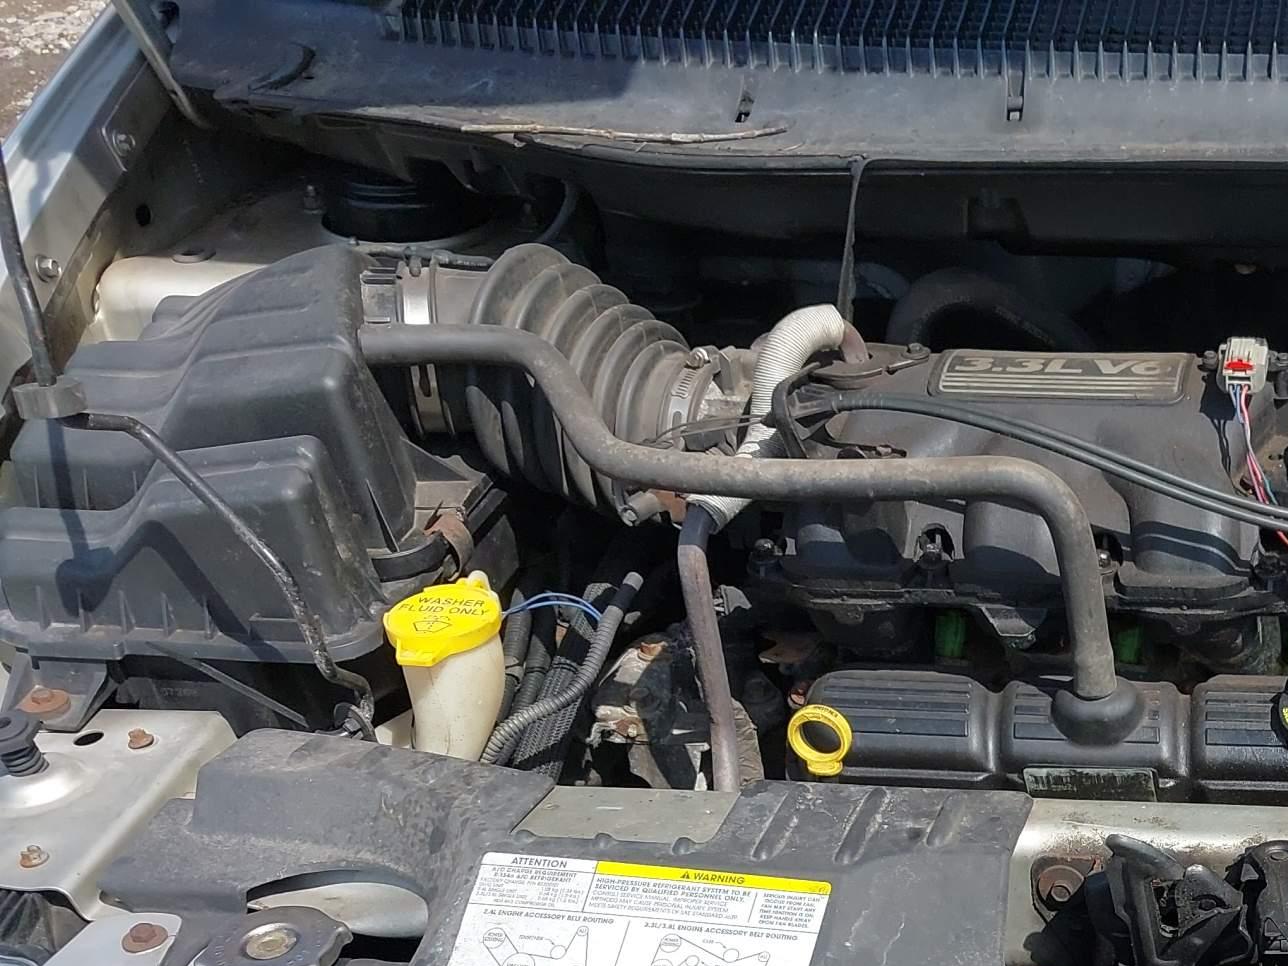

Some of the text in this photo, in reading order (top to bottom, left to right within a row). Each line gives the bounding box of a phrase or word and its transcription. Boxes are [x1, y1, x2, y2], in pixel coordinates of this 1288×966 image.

[954, 357, 1161, 375] 3.3L V6
[418, 597, 485, 607] WASHER
[398, 603, 489, 616] FLUID ONLY
[511, 857, 568, 869] ATTENTION
[530, 875, 572, 883] REFRIGERANT
[534, 869, 577, 878] REQUIREMENT
[694, 872, 745, 884] WARNING
[595, 883, 629, 892] SERVICED
[642, 887, 679, 896] QUALIFIED
[680, 891, 722, 900] PERSONNEL
[596, 877, 651, 887] HIGH-PRESSURE
[652, 882, 700, 891] REFRIGERANT
[702, 887, 729, 895] SYSTEM
[498, 909, 524, 918] ENGINE
[524, 911, 566, 921] ACCESSORY
[567, 914, 582, 922] BELT
[583, 916, 615, 924] ROUTING
[677, 925, 703, 933] ENGINE
[704, 927, 748, 937] ACCESSORY
[749, 930, 764, 938] BELT
[765, 932, 798, 941] ROUTING
